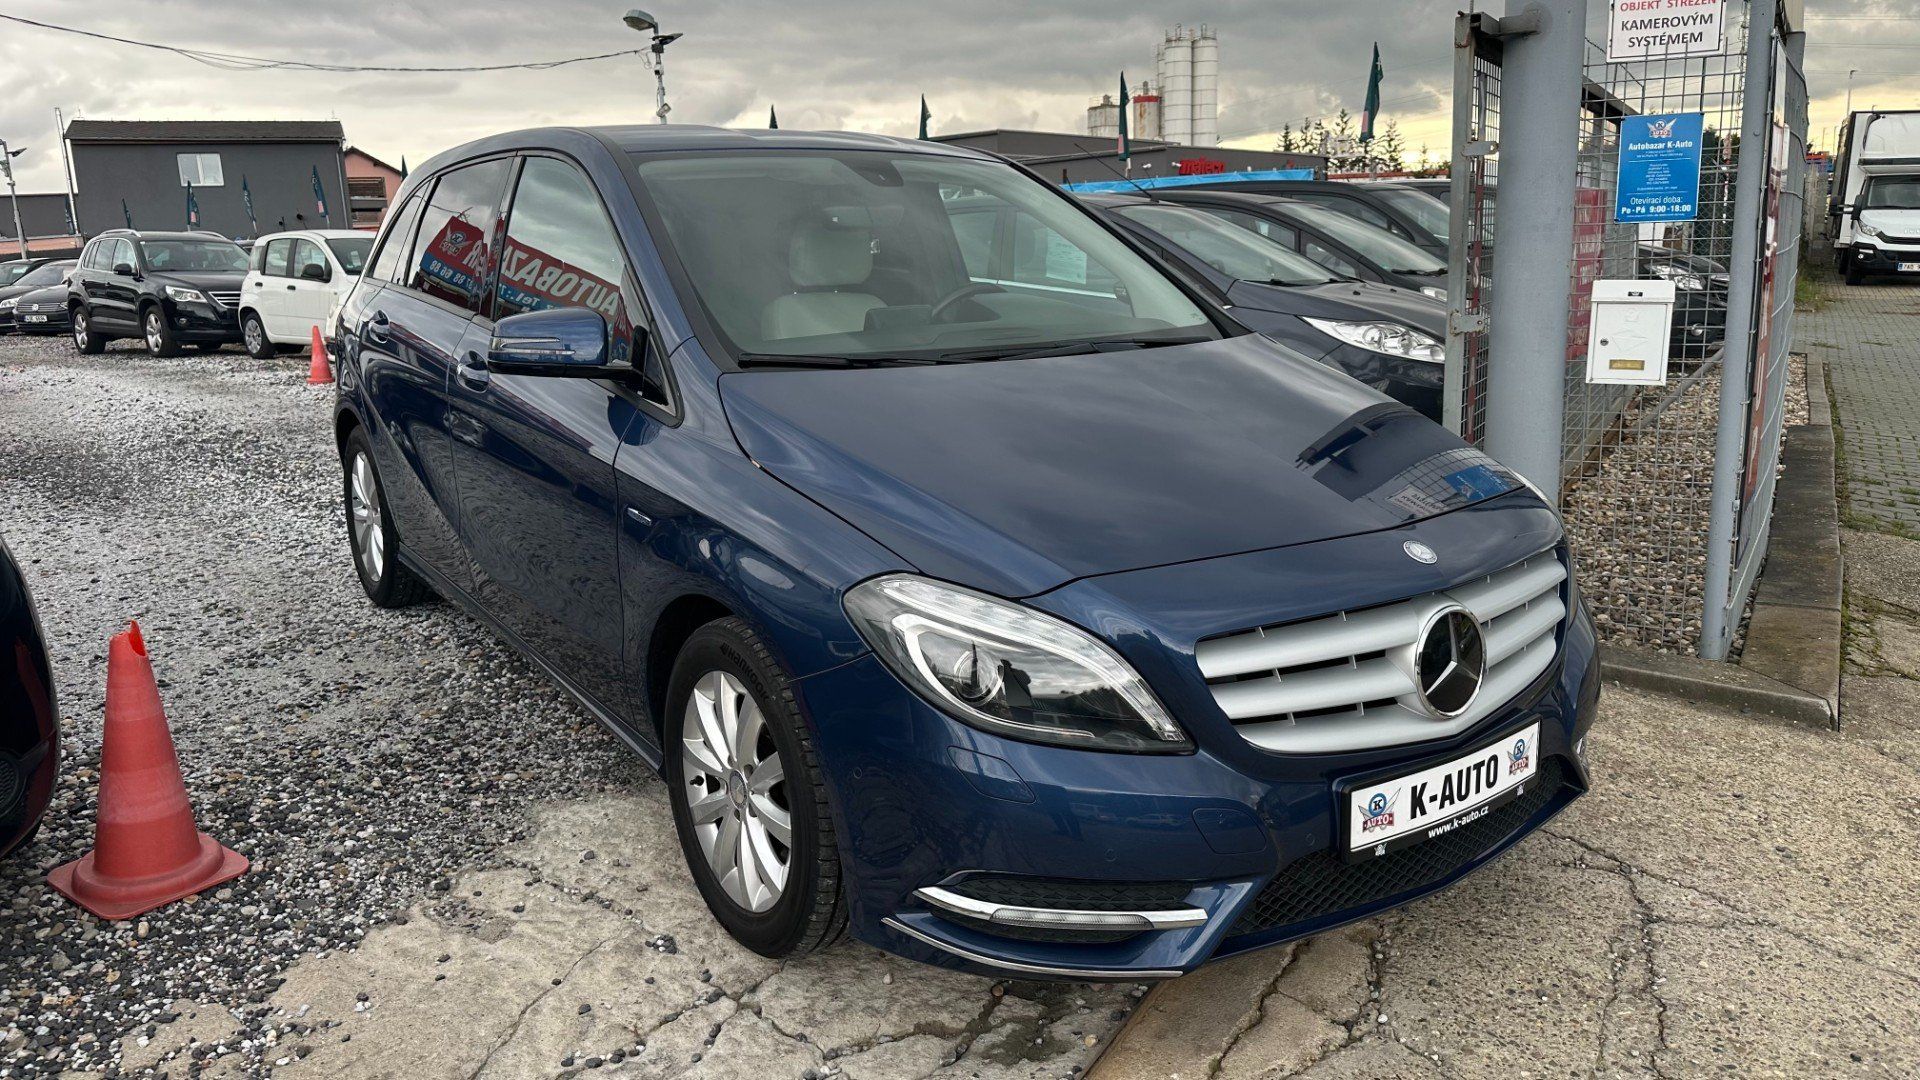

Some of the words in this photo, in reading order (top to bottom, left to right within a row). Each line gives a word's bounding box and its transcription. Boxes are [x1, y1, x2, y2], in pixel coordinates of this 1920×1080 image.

[1620, 0, 1660, 11] OBJEKT
[1621, 12, 1713, 31] KAMEROVÝM
[1628, 31, 1703, 47] SYSTÉMEM
[1628, 142, 1665, 151] Autobazar
[1667, 140, 1693, 148] K-Auto
[1410, 753, 1499, 820] K-AUTO
[1428, 806, 1489, 838] www.k-auto.cz
